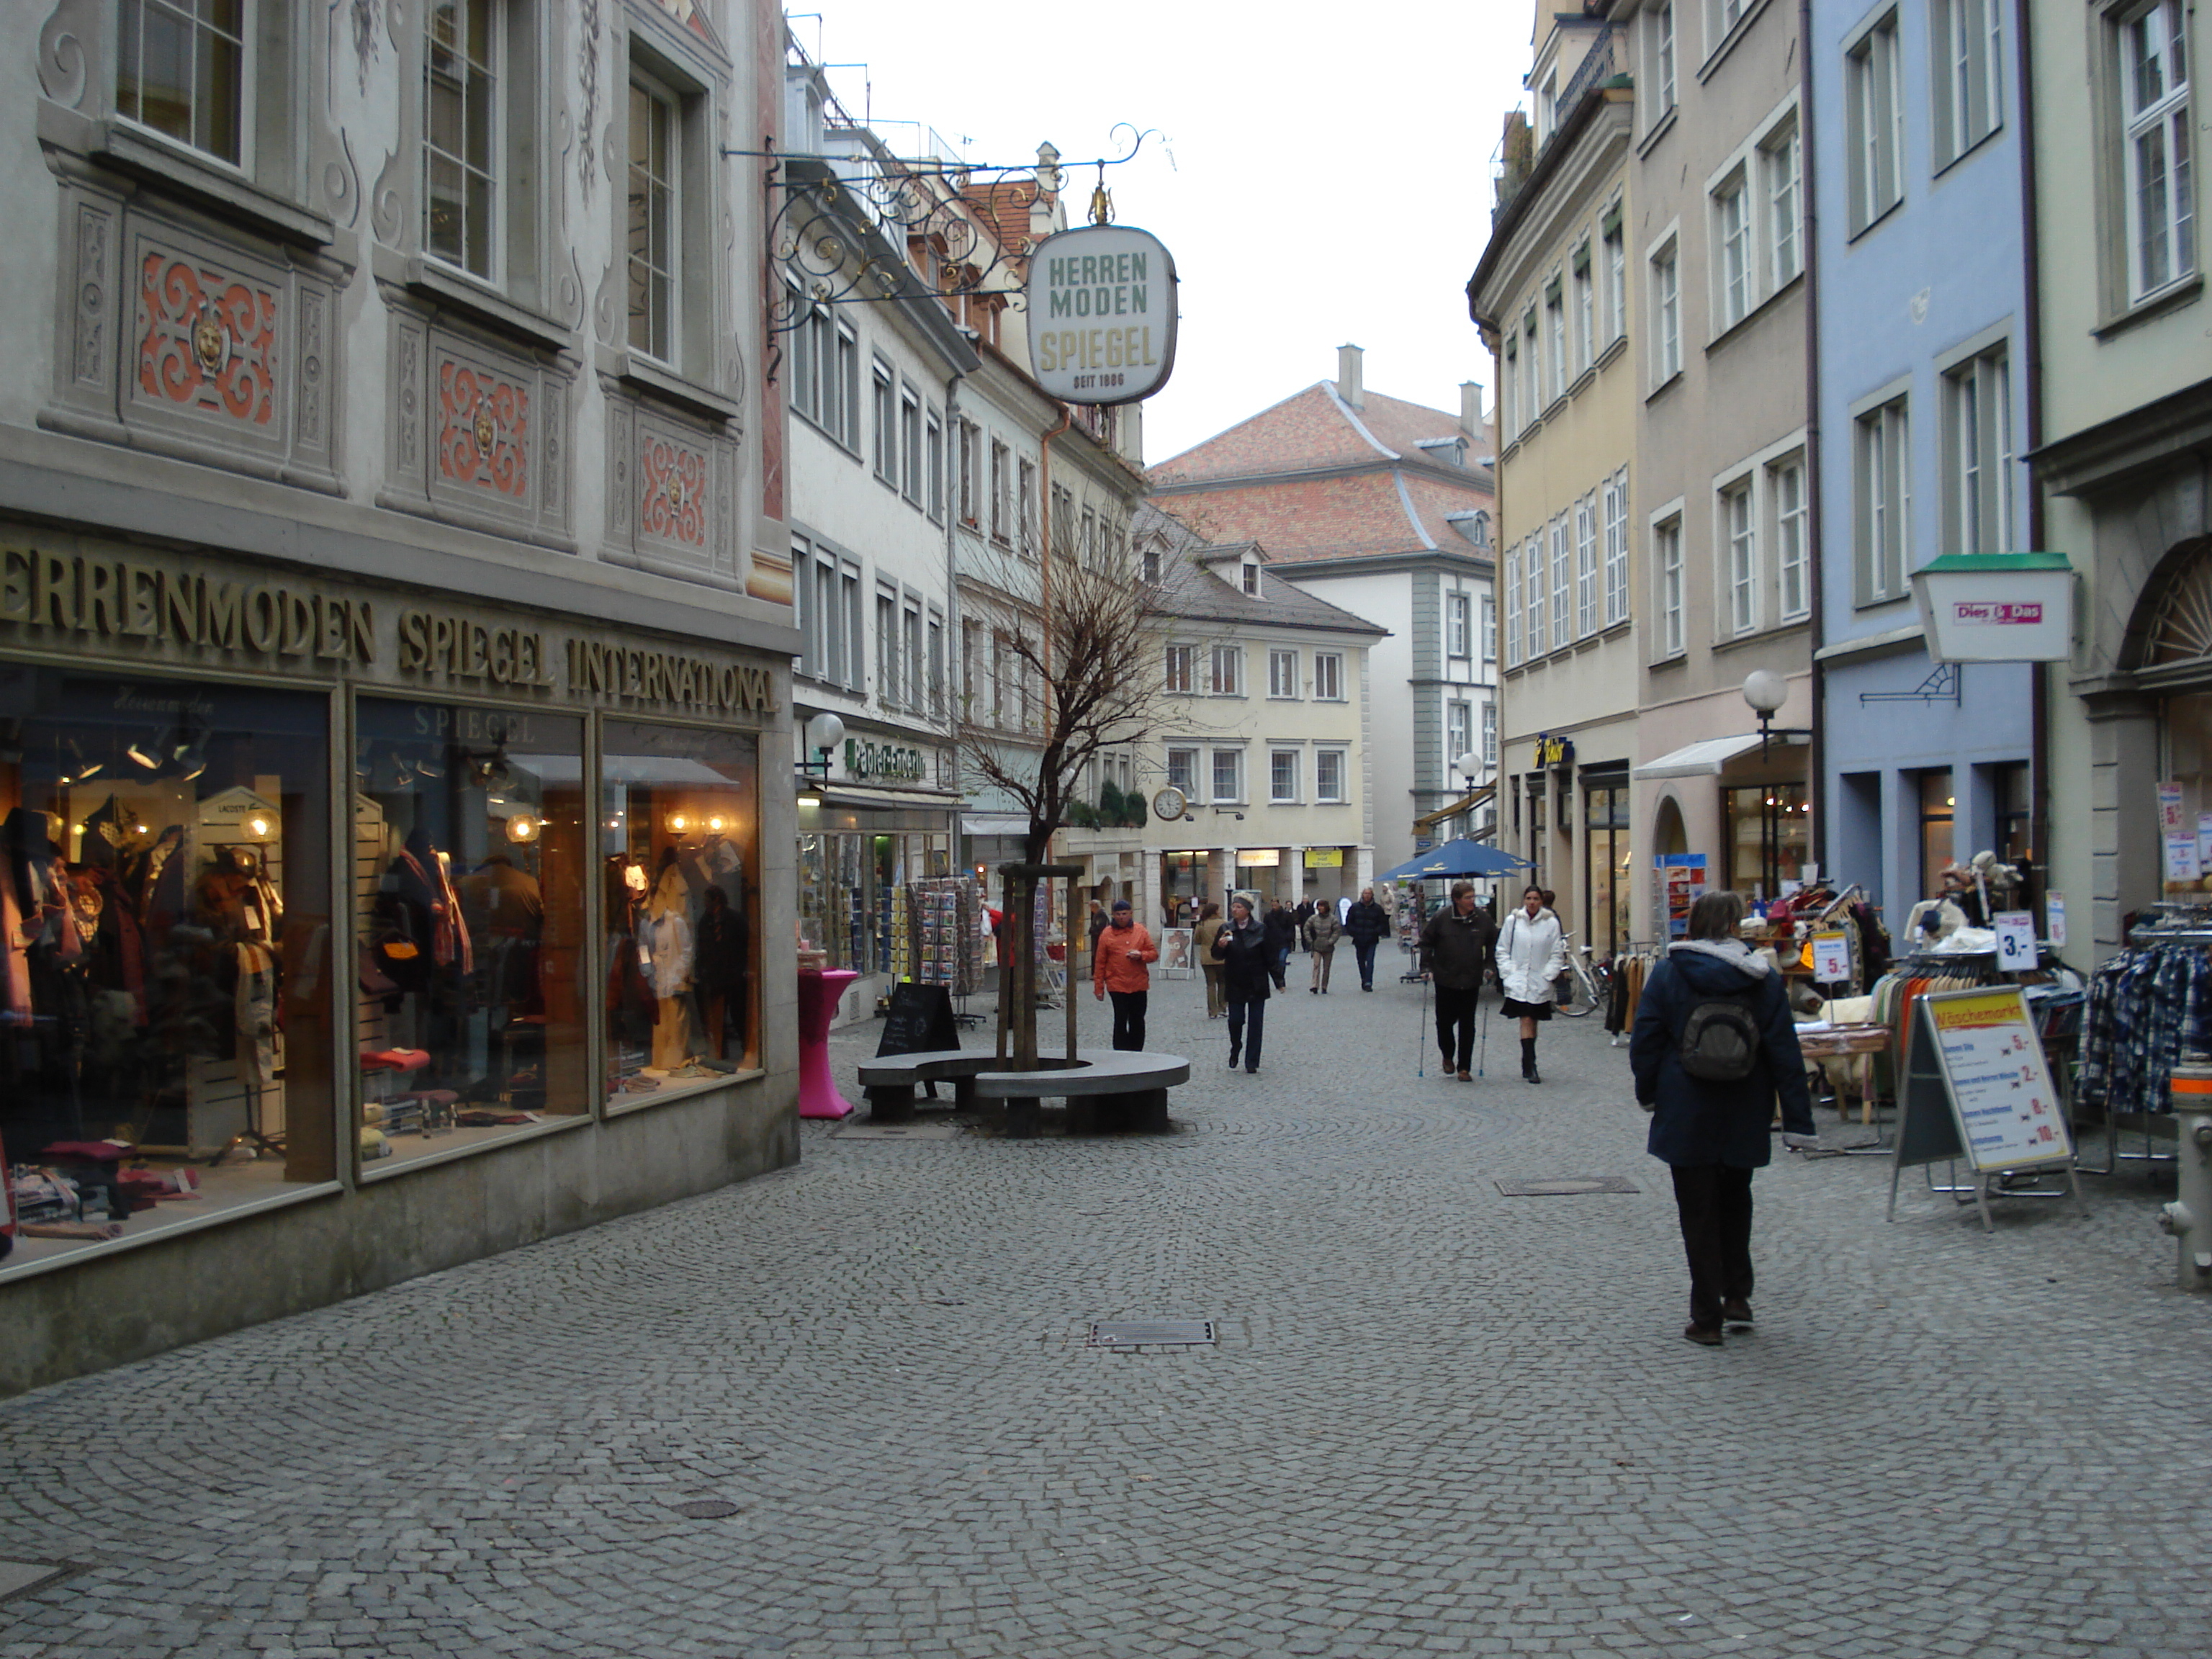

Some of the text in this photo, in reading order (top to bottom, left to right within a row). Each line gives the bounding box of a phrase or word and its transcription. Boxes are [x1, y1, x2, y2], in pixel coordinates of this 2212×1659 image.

[1050, 252, 1147, 287] HERREN
[1050, 284, 1147, 318] MODEN
[1040, 326, 1157, 372] SPIEGEL
[1074, 374, 1096, 389] SEIT
[1959, 606, 1989, 619] Dies
[2011, 604, 2039, 619] Das
[399, 608, 556, 687] SPIEGEL
[567, 638, 781, 714] INTERNATIONAL
[414, 705, 536, 743] SPIEGEL
[2003, 935, 2028, 958] 3,-
